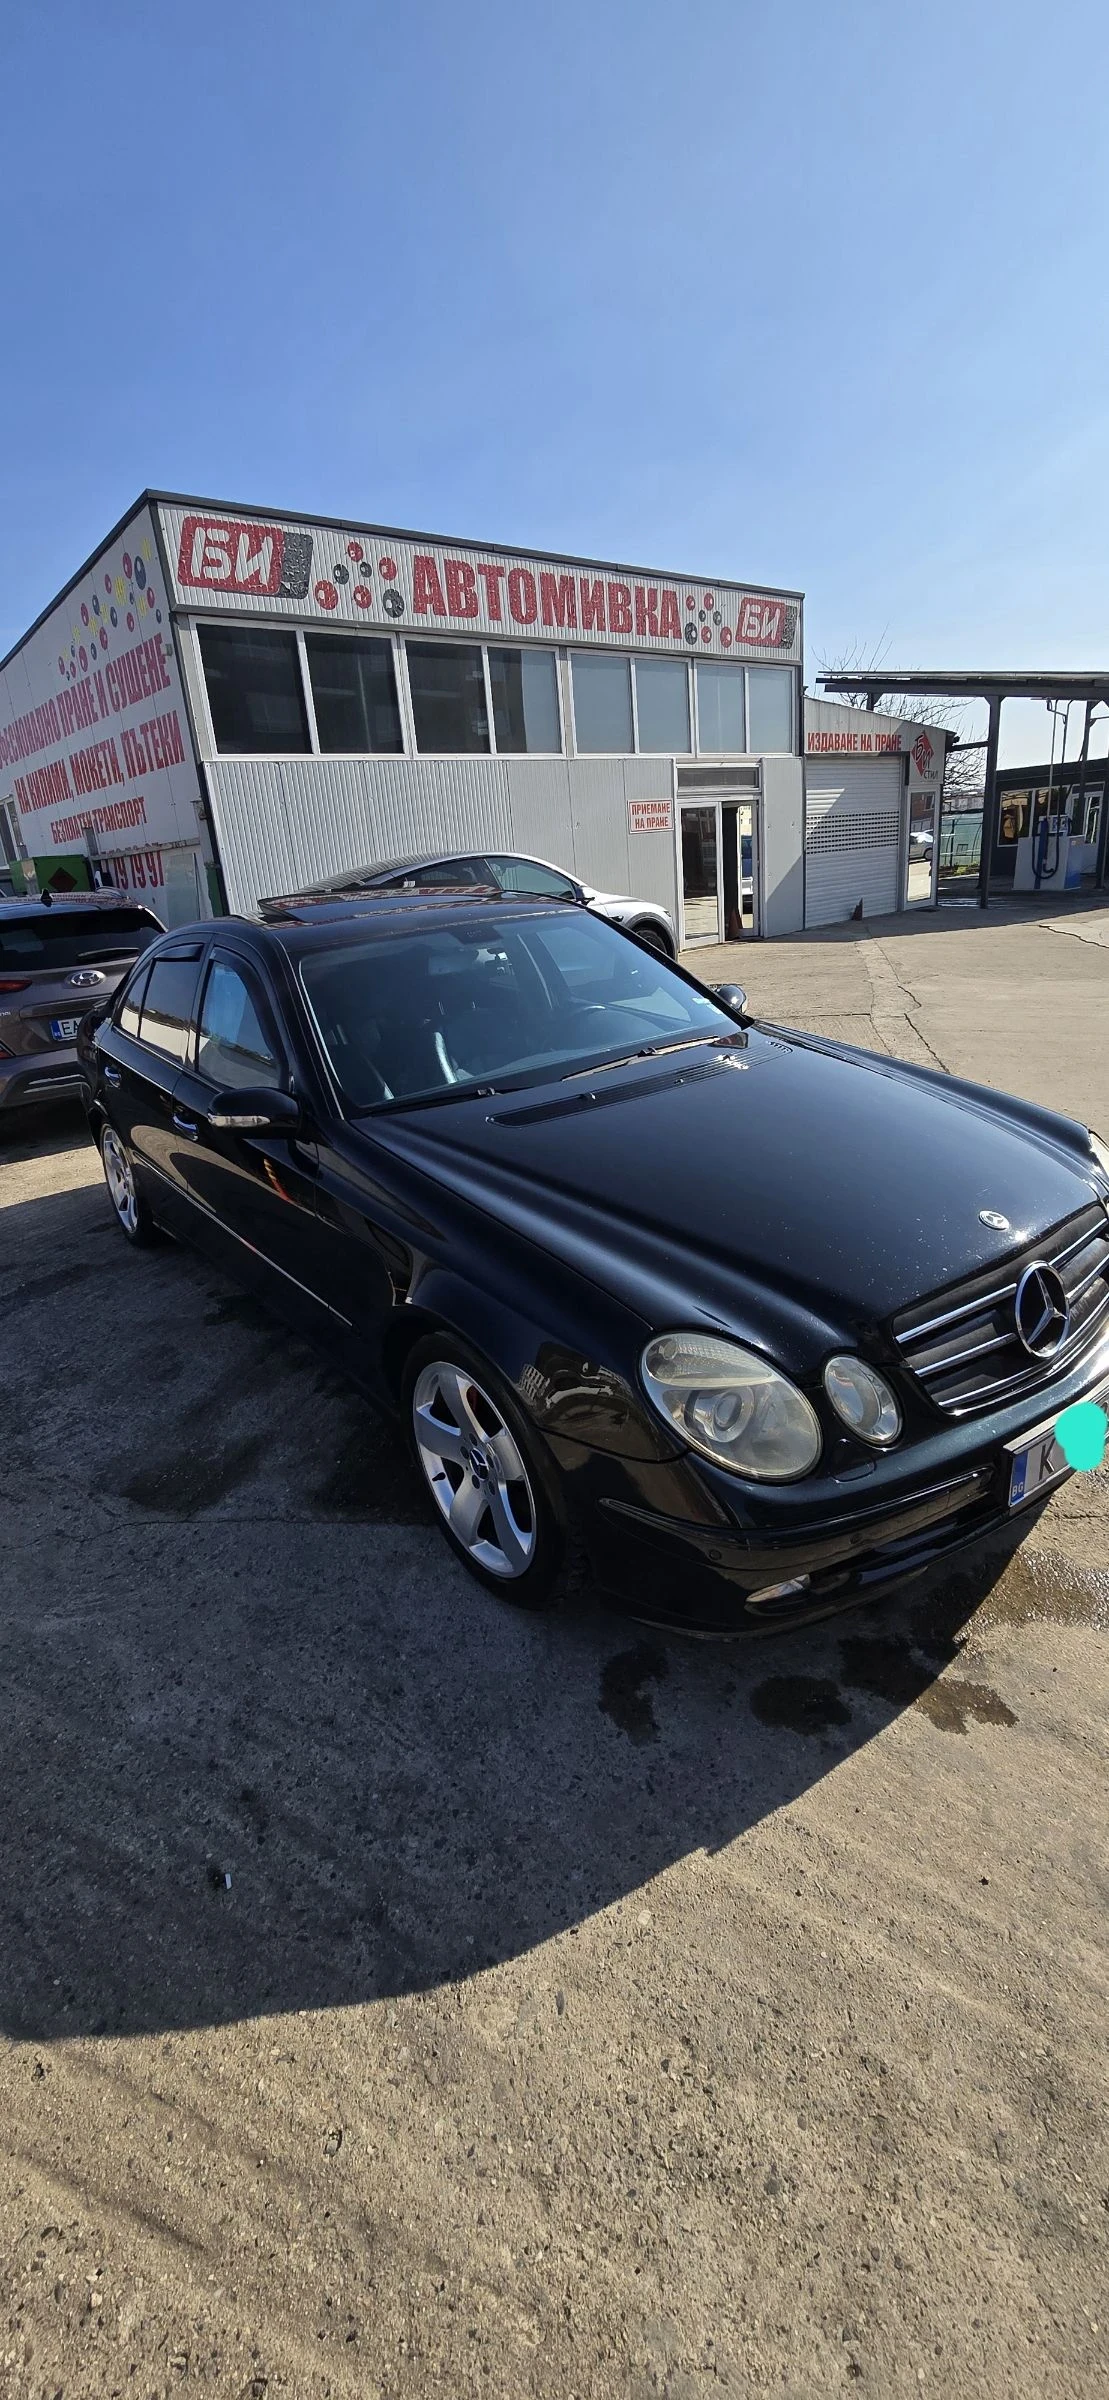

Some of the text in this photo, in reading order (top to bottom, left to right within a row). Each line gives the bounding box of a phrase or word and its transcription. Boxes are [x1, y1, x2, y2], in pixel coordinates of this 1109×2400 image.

[190, 526, 274, 586] БИ
[412, 554, 682, 640] АВТОМИВКА
[741, 603, 780, 641] БИ
[0, 632, 171, 769] ФЕСИОНАЛНО ПРАНЕ И СУШЕНЕ
[807, 732, 902, 752] ИЗДАВАНЕ НА ПРАНЕ
[14, 776, 32, 815] НА
[69, 737, 125, 796] МОКЕТИ,
[120, 709, 186, 779] ПЪТЕКИ
[91, 796, 147, 834] ТРАНСПОРТ
[631, 802, 671, 815] ПРИЕМАНЕ
[635, 816, 669, 829] НА ПРАНЕ
[1011, 1481, 1024, 1498] BG
